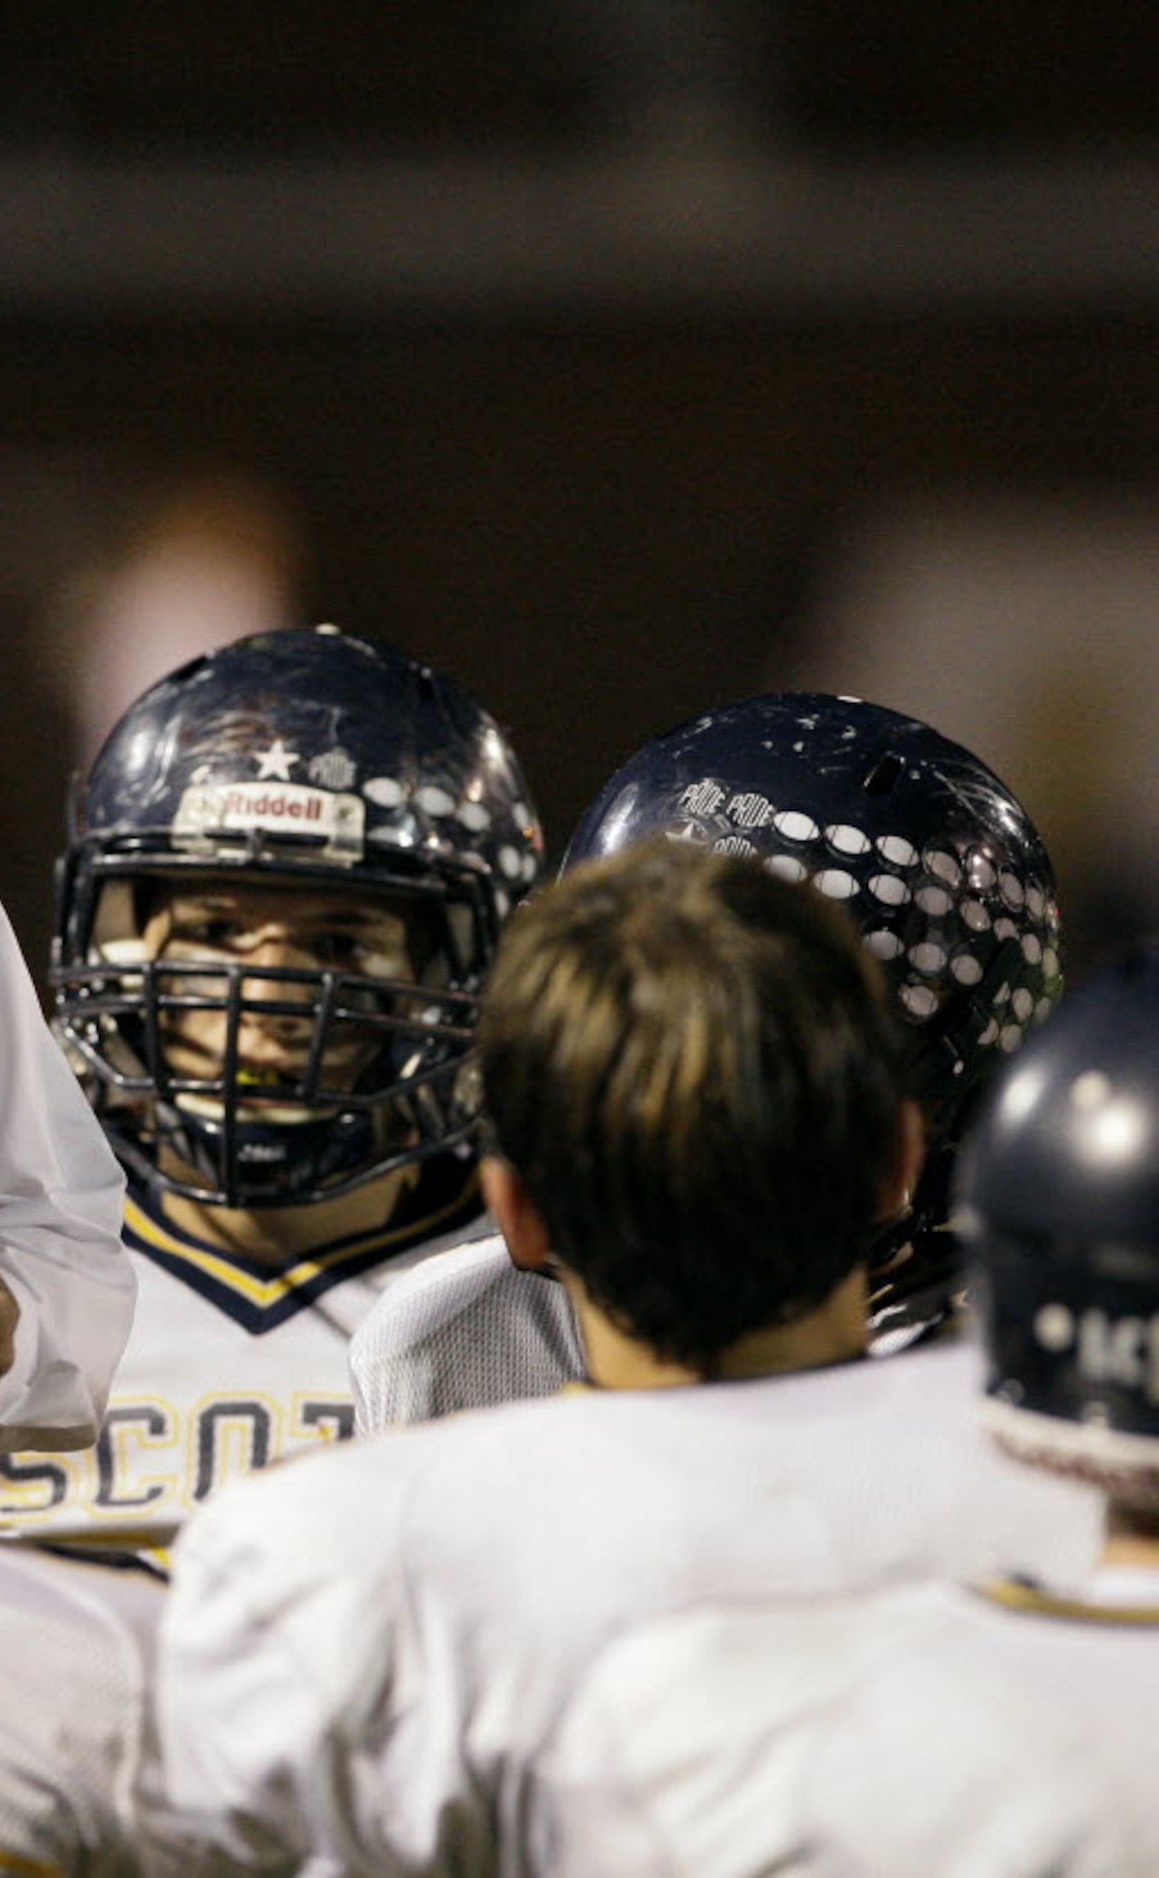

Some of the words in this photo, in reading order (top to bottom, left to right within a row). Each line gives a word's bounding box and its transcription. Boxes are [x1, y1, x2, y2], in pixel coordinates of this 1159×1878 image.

[225, 792, 321, 820] Riddell
[679, 778, 726, 816] PRIDE
[726, 793, 776, 828] PRIDE
